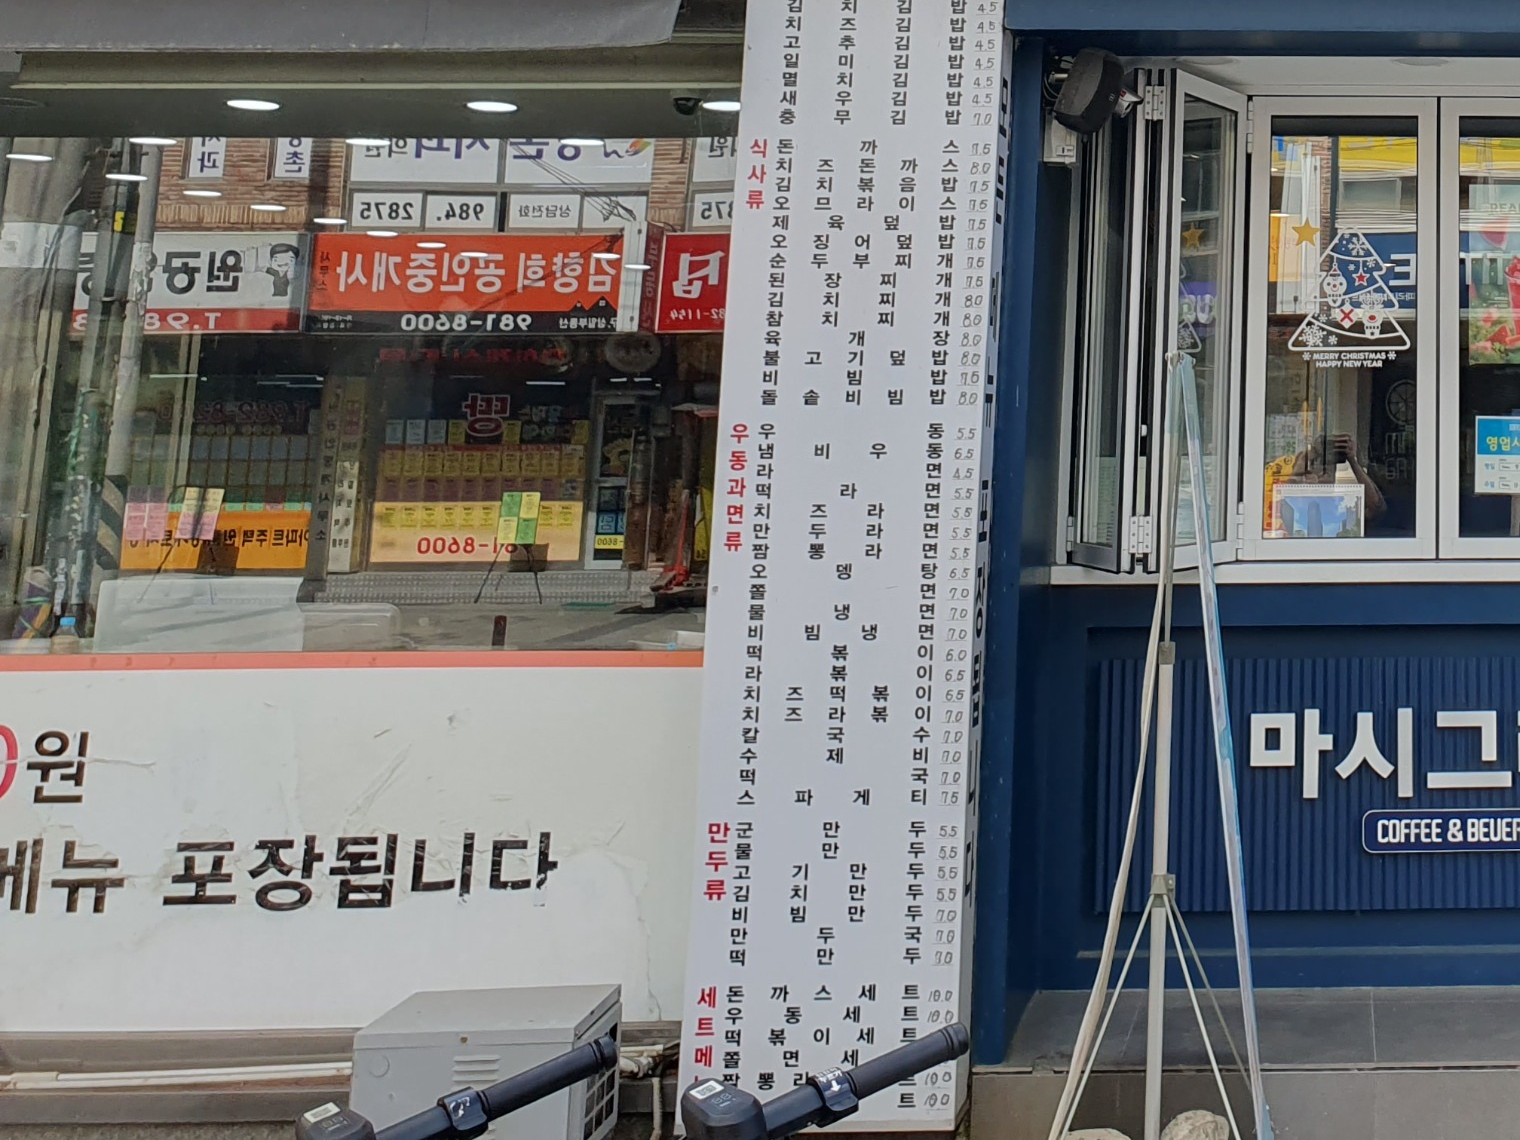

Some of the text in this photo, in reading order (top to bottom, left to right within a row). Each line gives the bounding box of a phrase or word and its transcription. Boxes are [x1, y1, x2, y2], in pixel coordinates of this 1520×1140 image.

[746, 138, 769, 210] 식사류
[703, 821, 730, 901] 만두류
[1377, 817, 1443, 844] COFFEE
[162, 830, 559, 913] 포장됩니다
[694, 986, 717, 1080] 세트메
